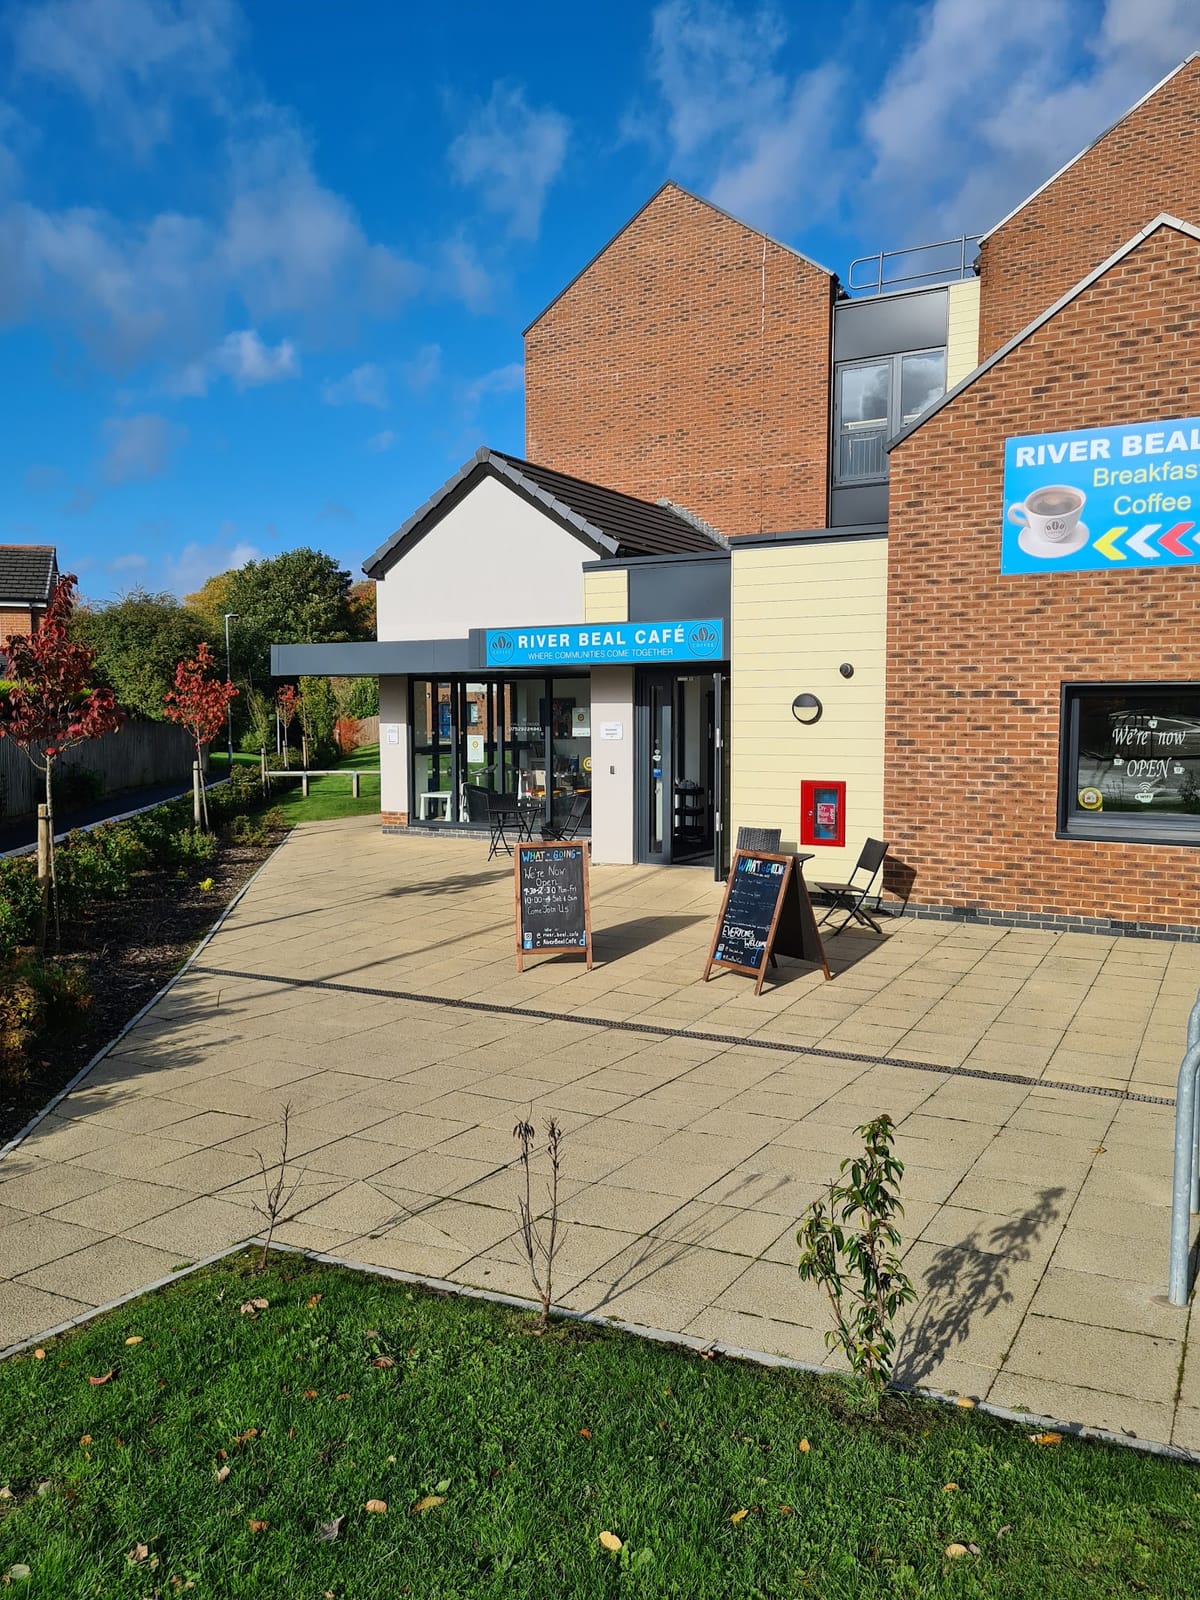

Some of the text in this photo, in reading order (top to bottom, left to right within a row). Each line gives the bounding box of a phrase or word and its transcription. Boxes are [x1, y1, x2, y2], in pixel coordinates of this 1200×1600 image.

[1016, 438, 1111, 468] RIVER
[1092, 460, 1200, 488] Breakfas
[1113, 493, 1192, 516] Coffee
[518, 624, 686, 650] RIVER BEAL CAFÉ
[527, 647, 674, 660] WHERE COMMUNITIES COME TOGETHER
[1158, 731, 1186, 746] now
[1126, 757, 1172, 779] OPEN
[521, 850, 546, 863] WHAT
[548, 864, 566, 876] Now
[535, 878, 558, 888] Open
[558, 903, 569, 913] Us
